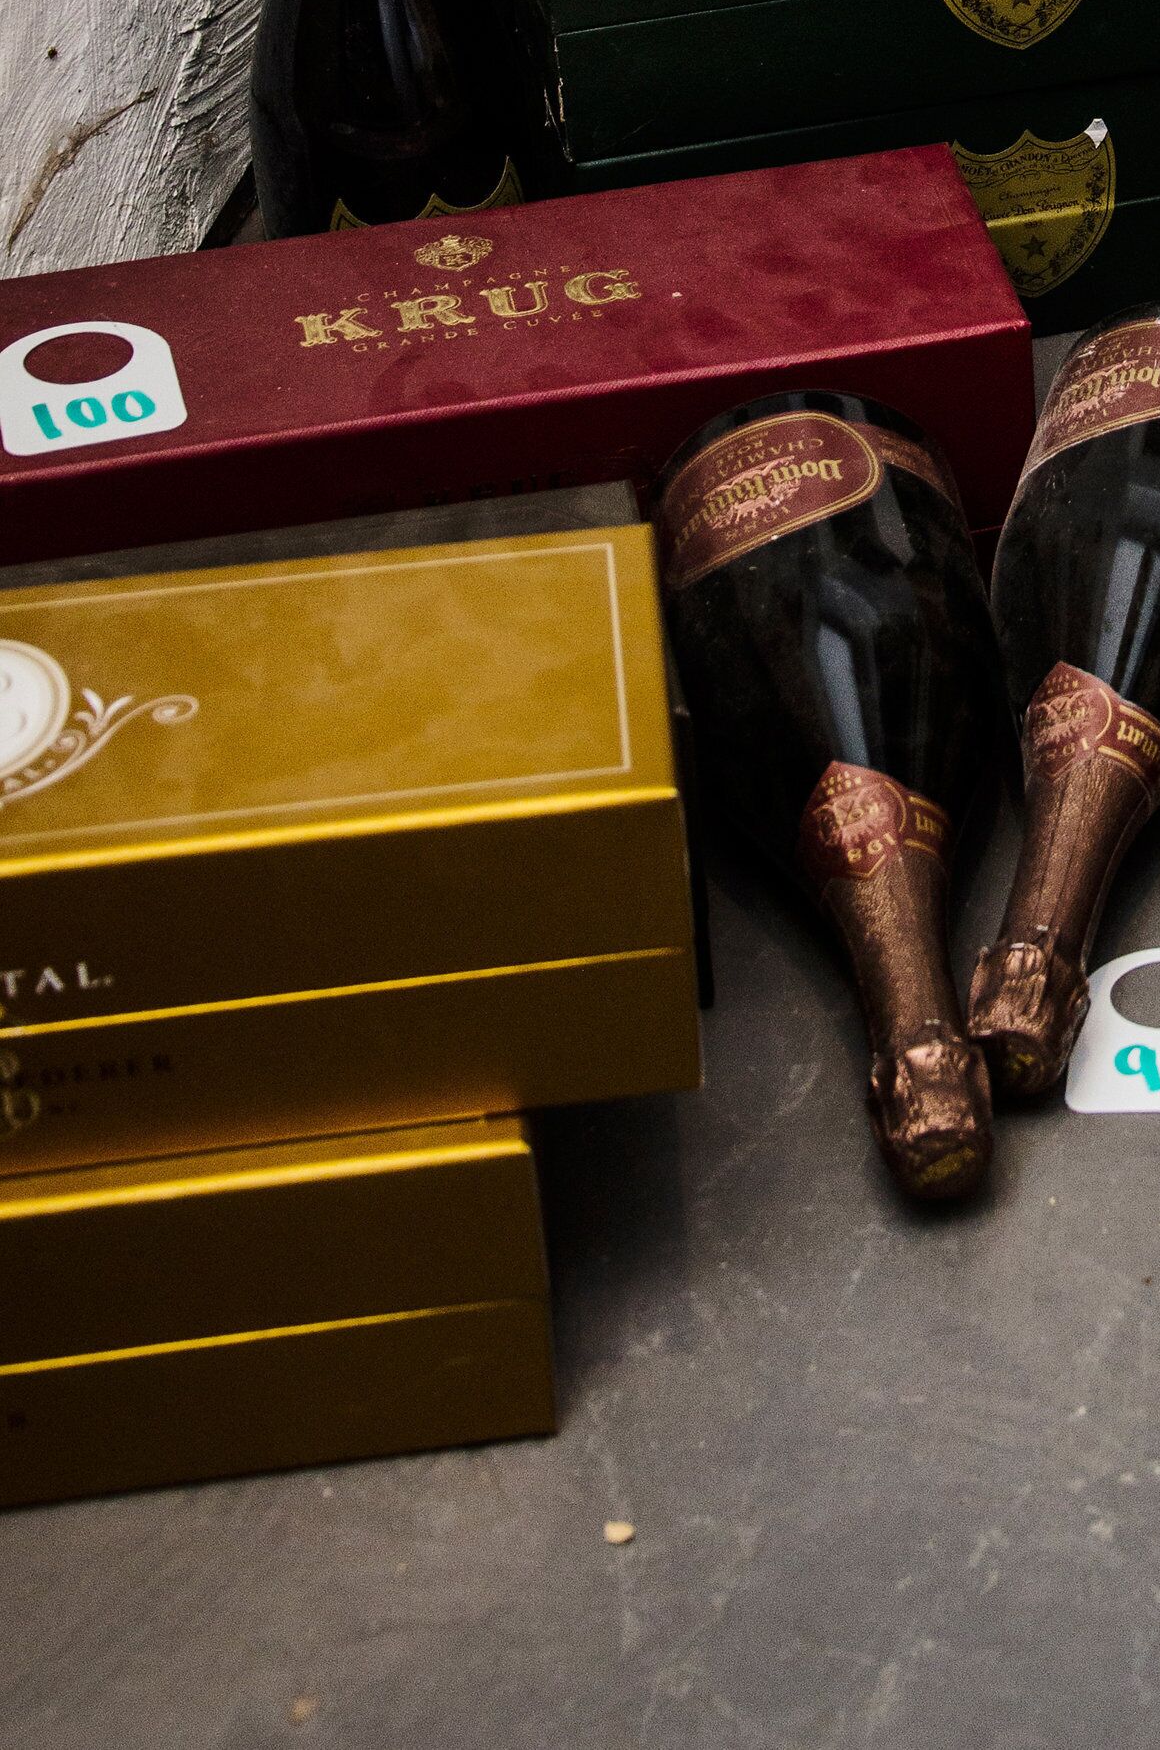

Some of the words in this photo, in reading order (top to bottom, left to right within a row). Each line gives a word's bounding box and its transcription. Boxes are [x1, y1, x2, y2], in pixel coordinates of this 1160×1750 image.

[357, 265, 572, 303] CHAMPAGNE
[294, 270, 642, 347] KRUG
[352, 328, 480, 353] GRANDE
[32, 390, 156, 440] 100
[770, 458, 843, 483] Dom
